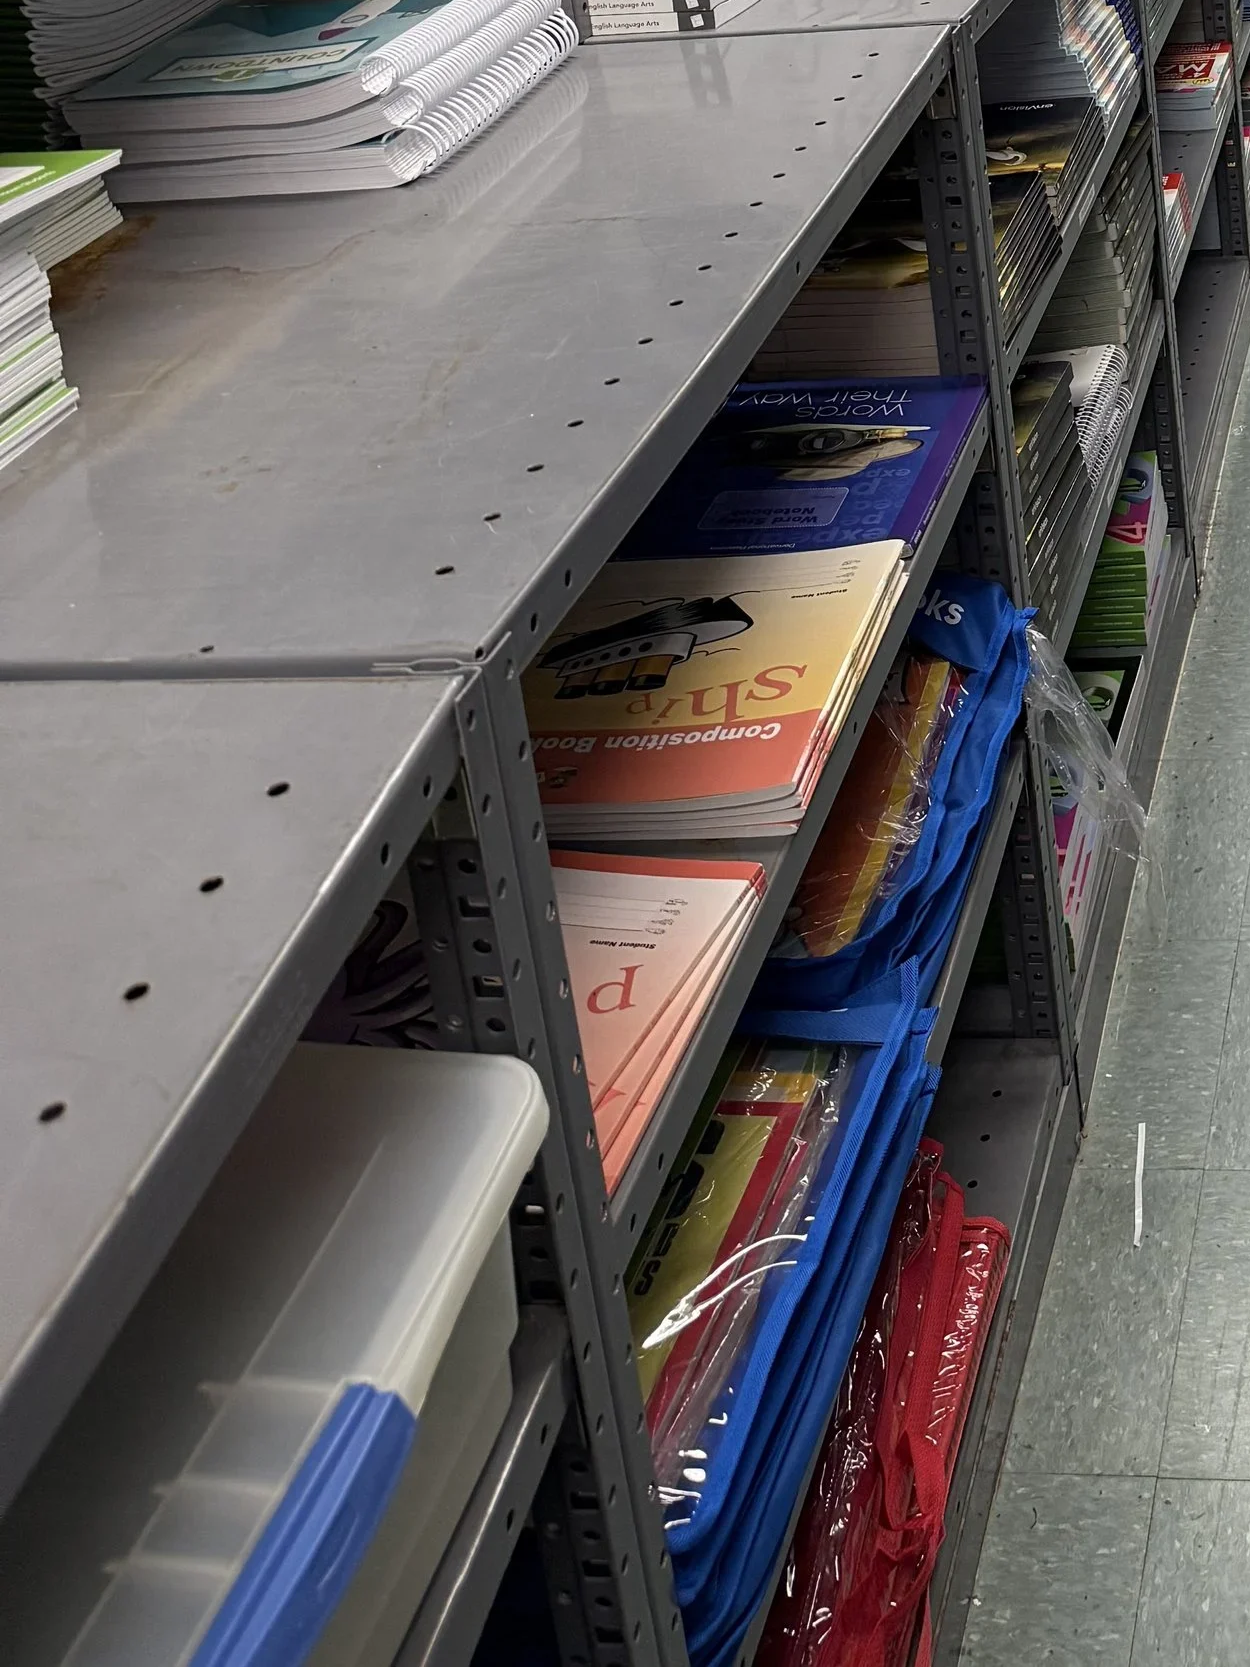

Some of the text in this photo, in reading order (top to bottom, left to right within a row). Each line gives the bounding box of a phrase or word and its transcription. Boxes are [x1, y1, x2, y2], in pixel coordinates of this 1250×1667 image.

[588, 0, 655, 11] nglish Language Arts
[613, 20, 645, 31] Language
[645, 20, 660, 28] Arts
[172, 47, 347, 73] COUNTDOWN
[739, 389, 912, 406] Their Way
[796, 403, 905, 419] Words
[626, 663, 808, 726] ship
[605, 722, 782, 752] Composition
[588, 938, 657, 951] Student Name
